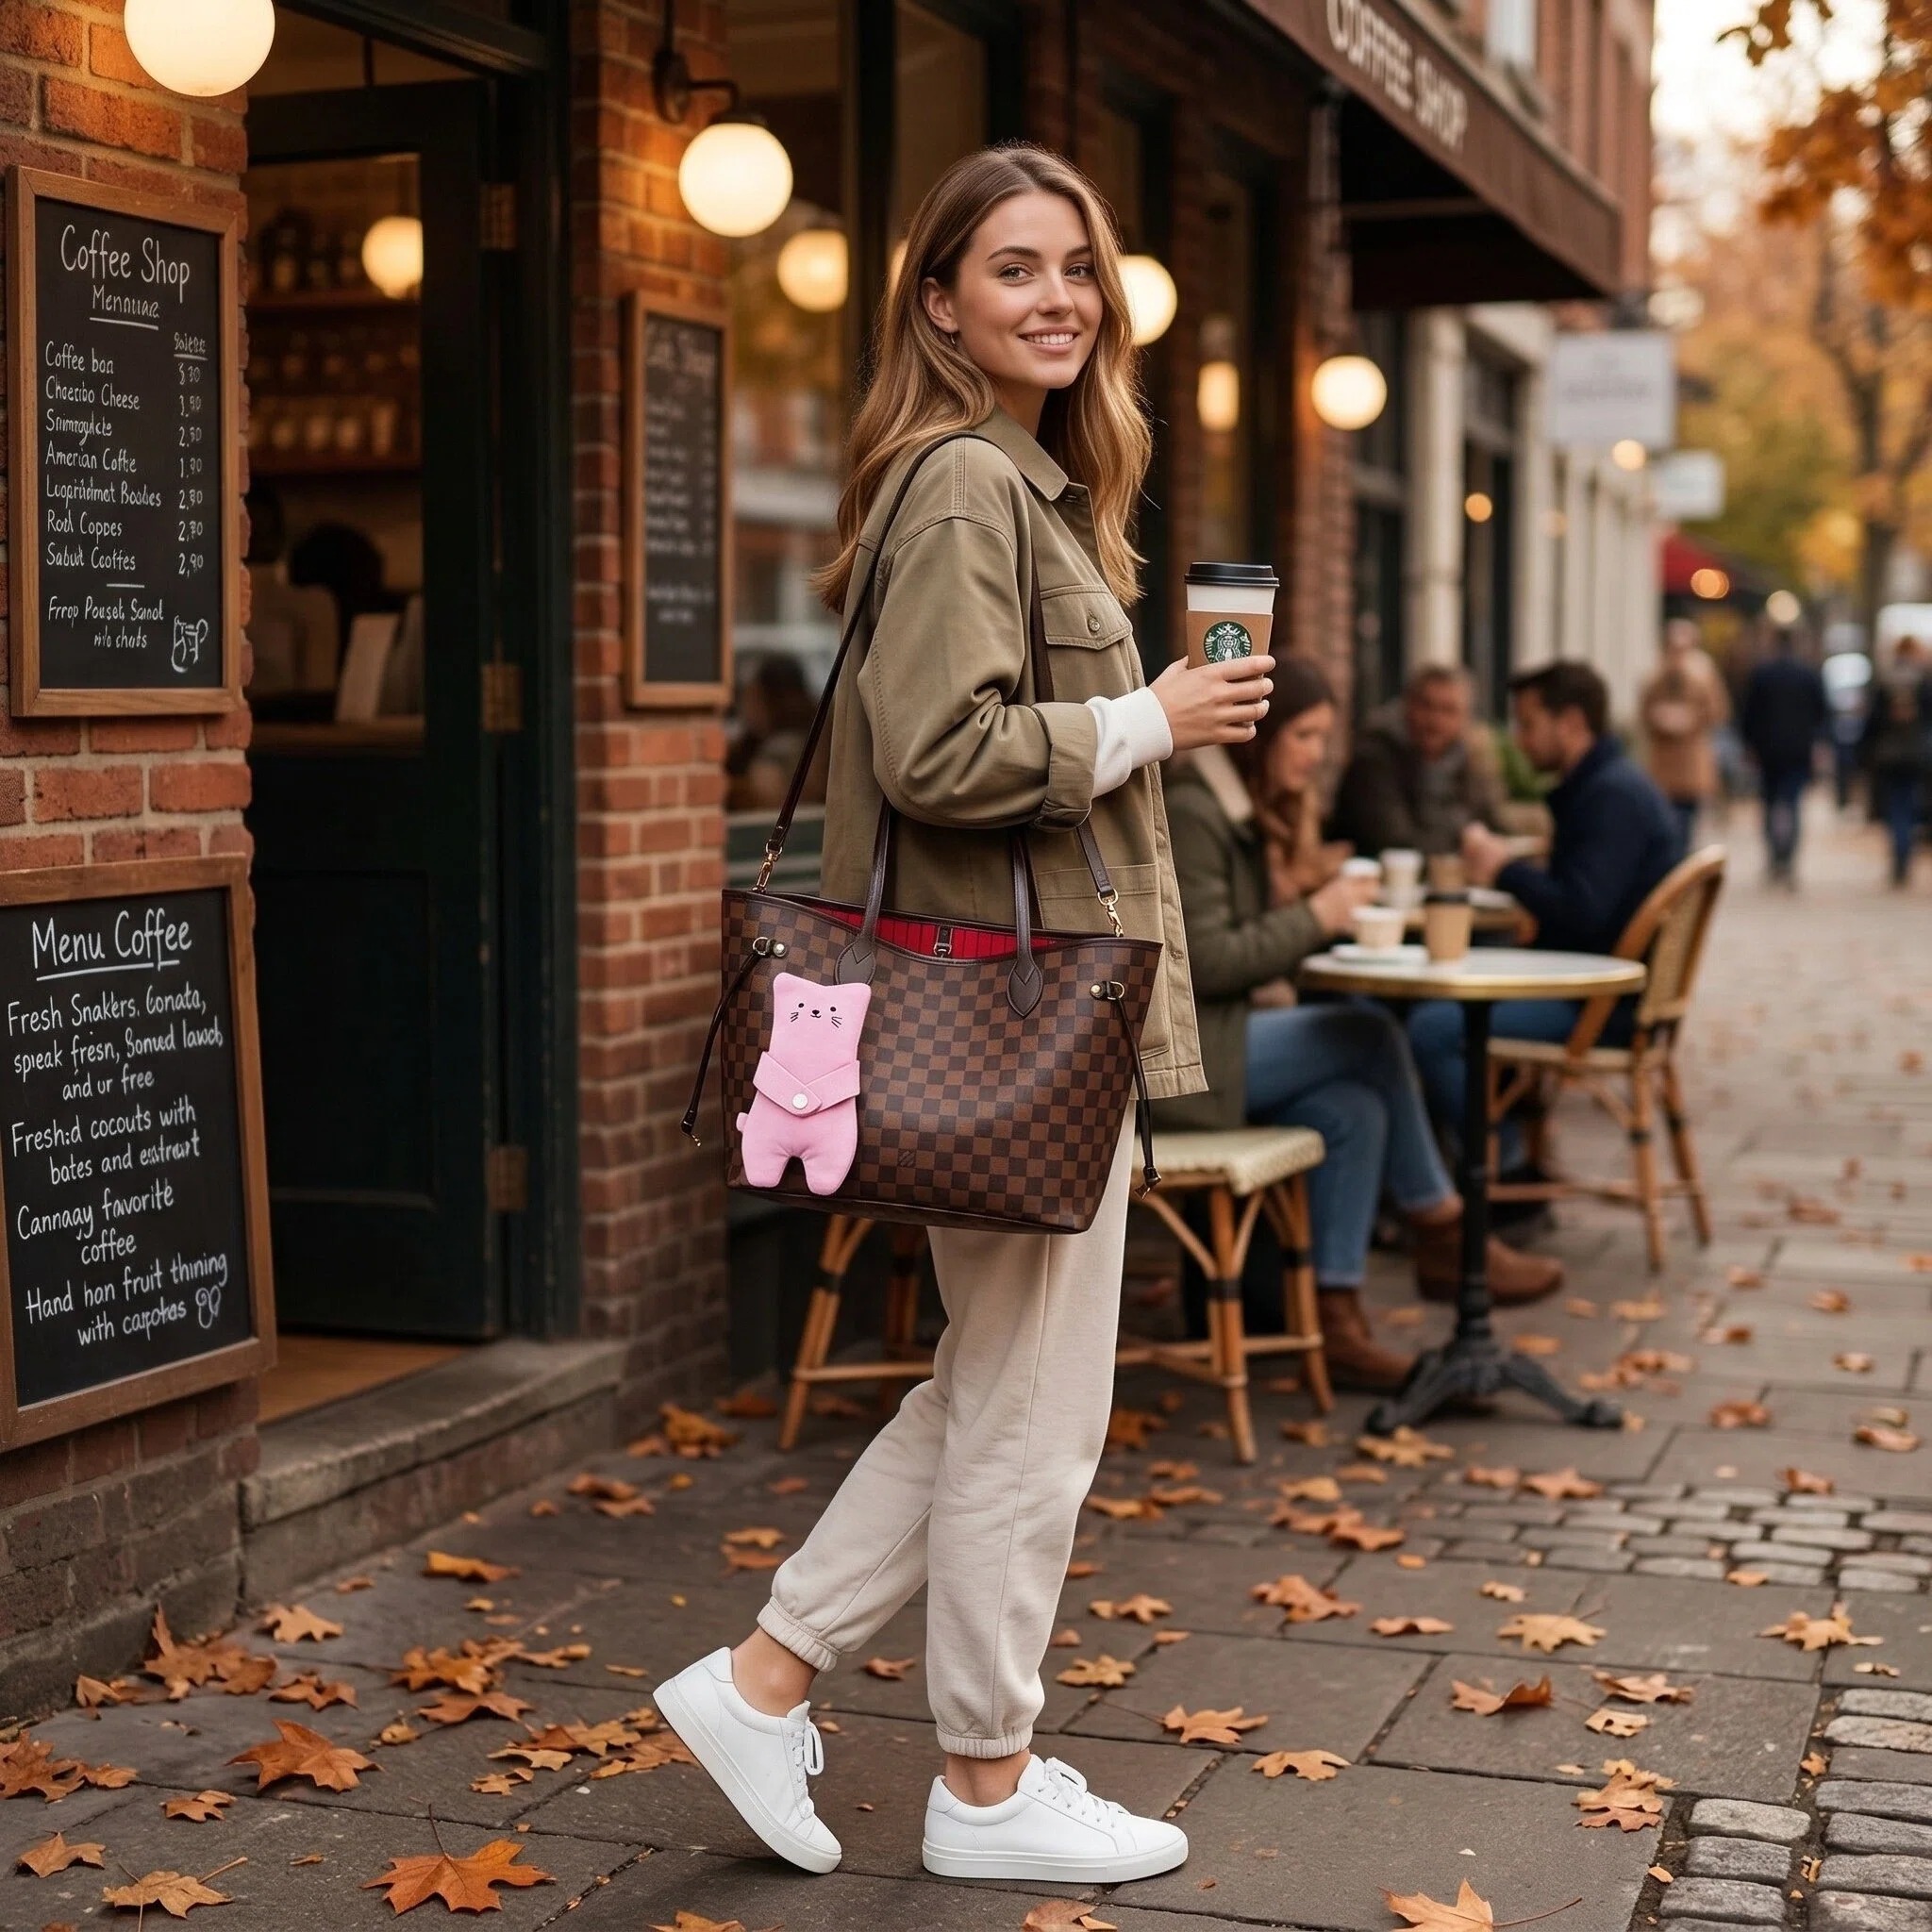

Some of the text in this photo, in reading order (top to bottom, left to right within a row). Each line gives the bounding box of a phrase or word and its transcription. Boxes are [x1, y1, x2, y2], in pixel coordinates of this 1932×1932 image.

[1416, 56, 1468, 148] SHOP
[60, 225, 191, 304] Coffee Shop
[45, 341, 86, 372] Coffee
[101, 382, 141, 410] Cheese
[32, 908, 192, 972] Menu Coffee
[8, 995, 63, 1037] Fresh
[62, 1072, 92, 1101] and
[122, 1062, 156, 1095] free
[91, 1104, 152, 1140] cocouts
[159, 1094, 196, 1126] with
[101, 1142, 133, 1173] and
[102, 1177, 175, 1222] favorite
[81, 1226, 137, 1265] coffee
[25, 1279, 74, 1324] Hand
[123, 1257, 162, 1301] fruit
[170, 1252, 228, 1288] thining
[77, 1310, 115, 1346] with
